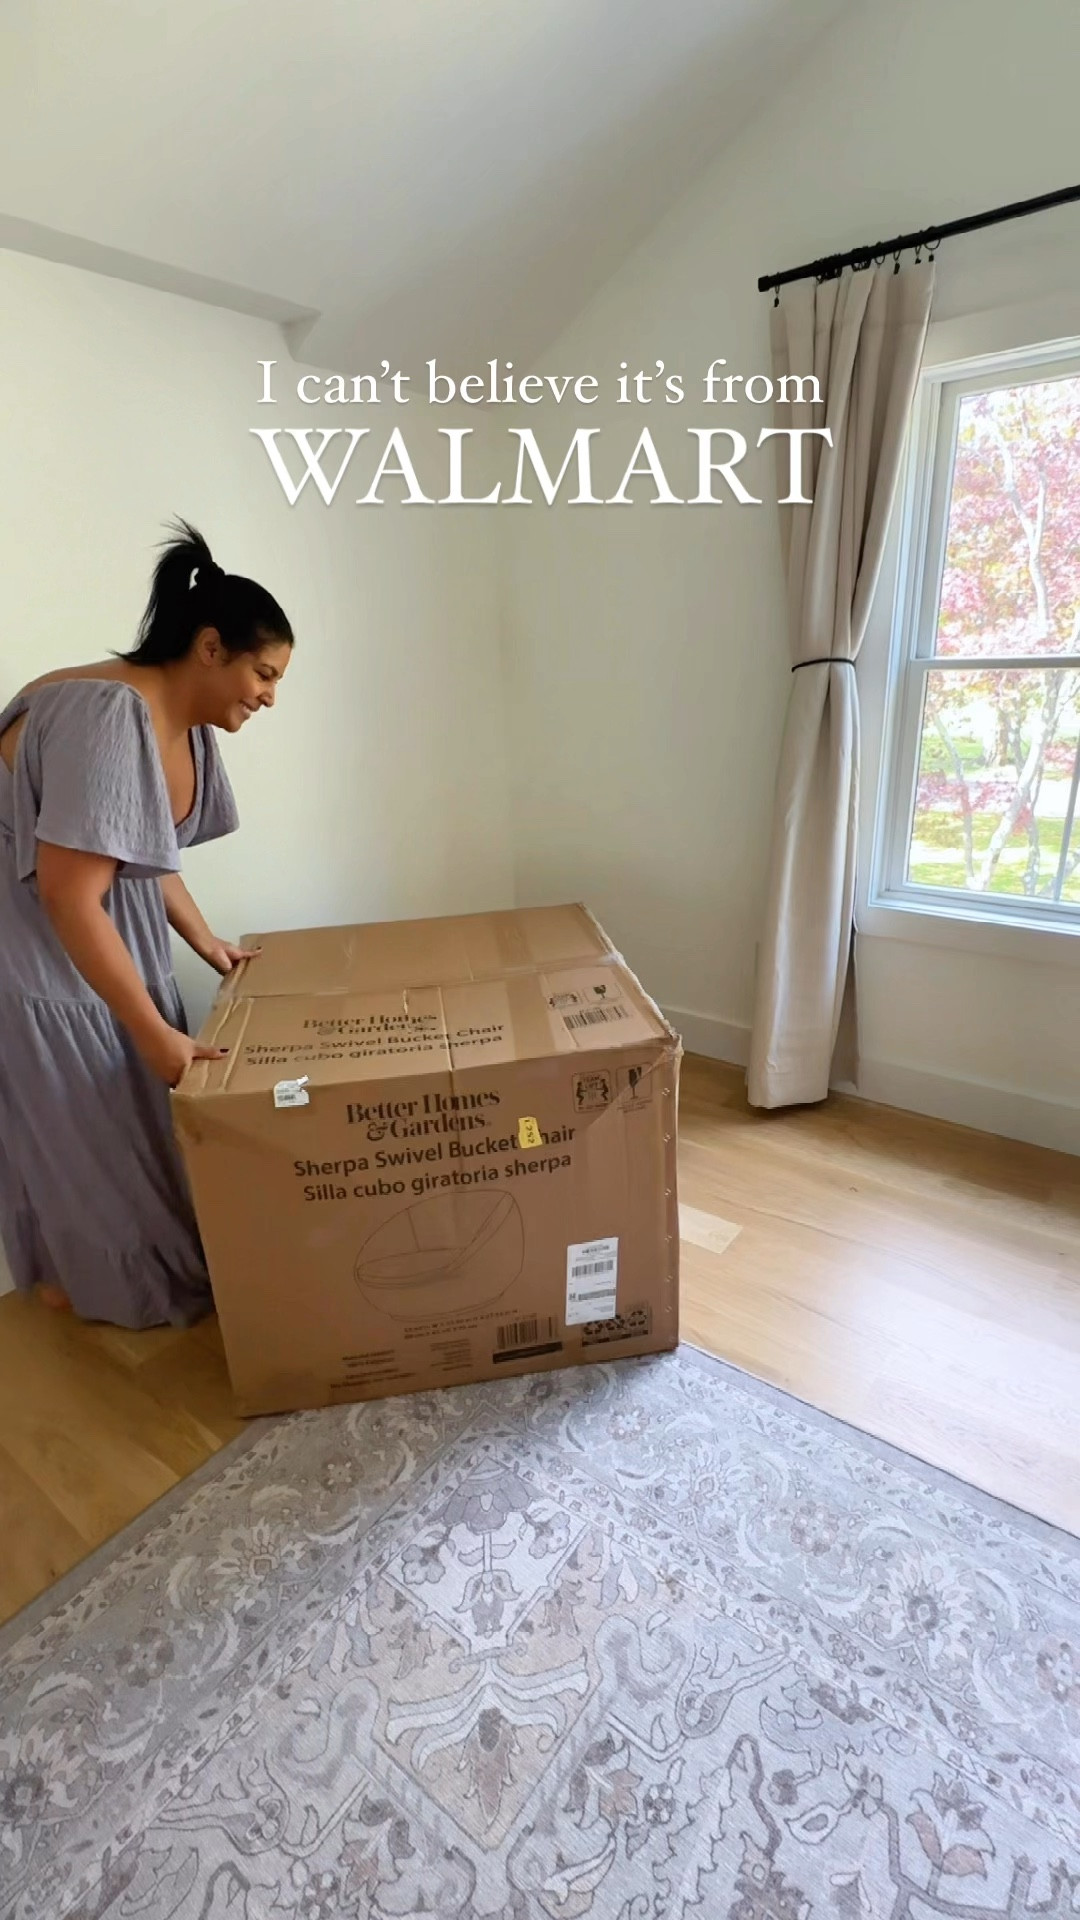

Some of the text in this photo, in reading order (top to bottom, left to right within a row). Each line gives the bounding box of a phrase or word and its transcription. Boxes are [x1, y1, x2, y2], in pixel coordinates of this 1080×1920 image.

[245, 1024, 504, 1055] Sherpa Swivel Bucket Chair
[303, 1018, 365, 1029] Better
[247, 1034, 502, 1065] Silla cubo giratoria sherpa
[346, 1089, 500, 1124] Better Homes
[294, 1125, 576, 1182] Sherpa Swivel Bucket hair
[303, 1152, 571, 1201] Silla cubo giratoria sherpa
